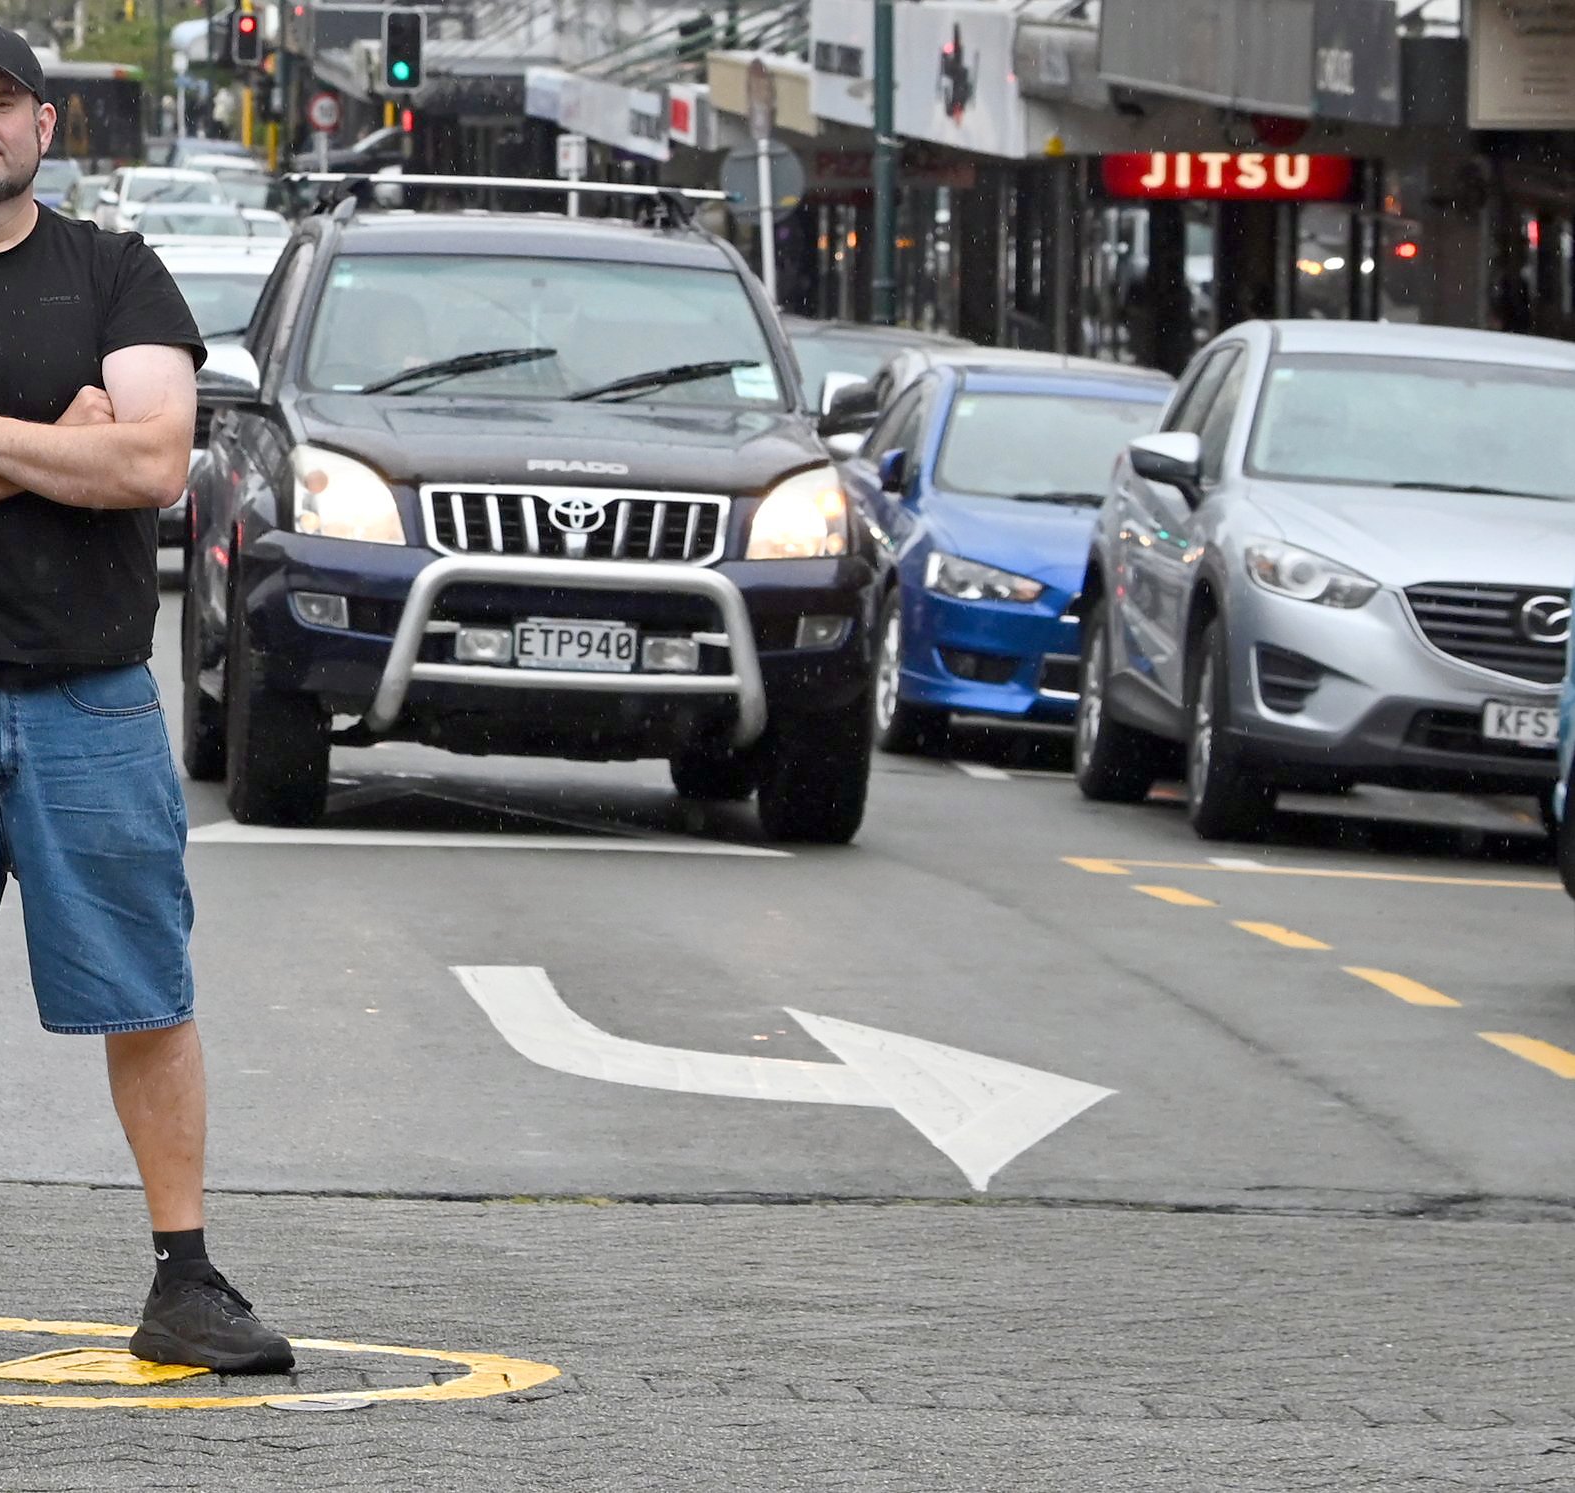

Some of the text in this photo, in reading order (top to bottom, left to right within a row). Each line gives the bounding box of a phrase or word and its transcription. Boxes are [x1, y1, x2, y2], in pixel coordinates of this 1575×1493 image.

[1140, 151, 1310, 190] JITSU
[527, 459, 628, 475] PRADO
[519, 627, 633, 660] ETP940
